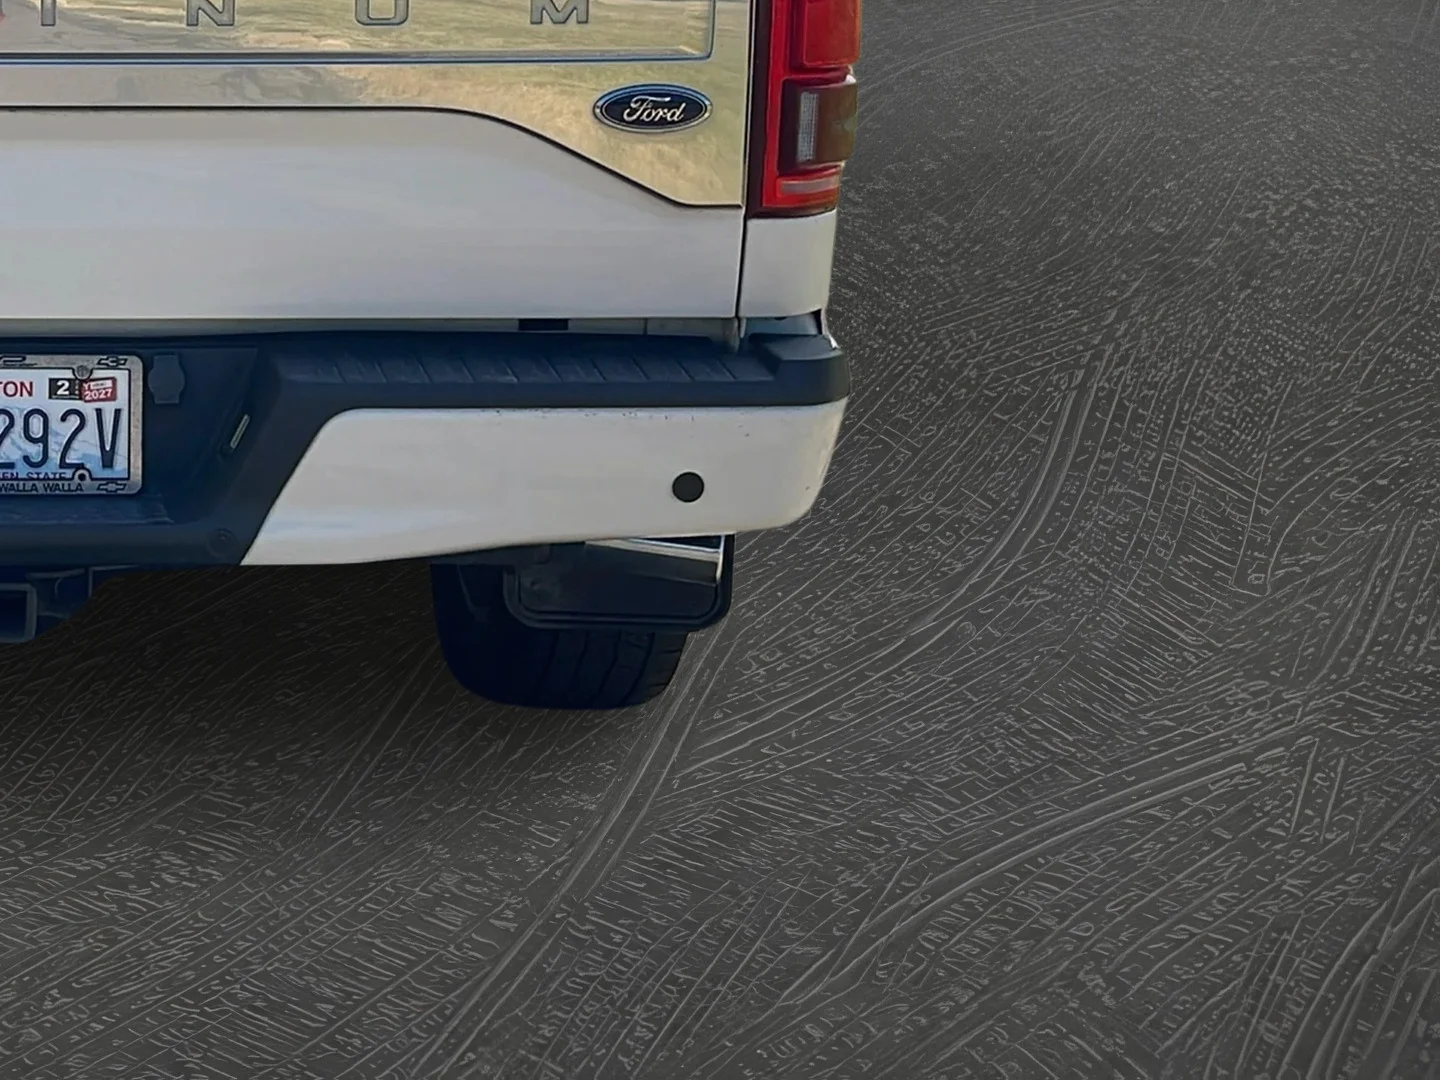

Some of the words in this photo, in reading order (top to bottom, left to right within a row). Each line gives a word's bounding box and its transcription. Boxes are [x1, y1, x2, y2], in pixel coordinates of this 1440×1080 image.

[623, 95, 686, 122] Ford
[56, 379, 70, 396] 2
[83, 388, 113, 401] 2027
[42, 482, 84, 493] WALLA
